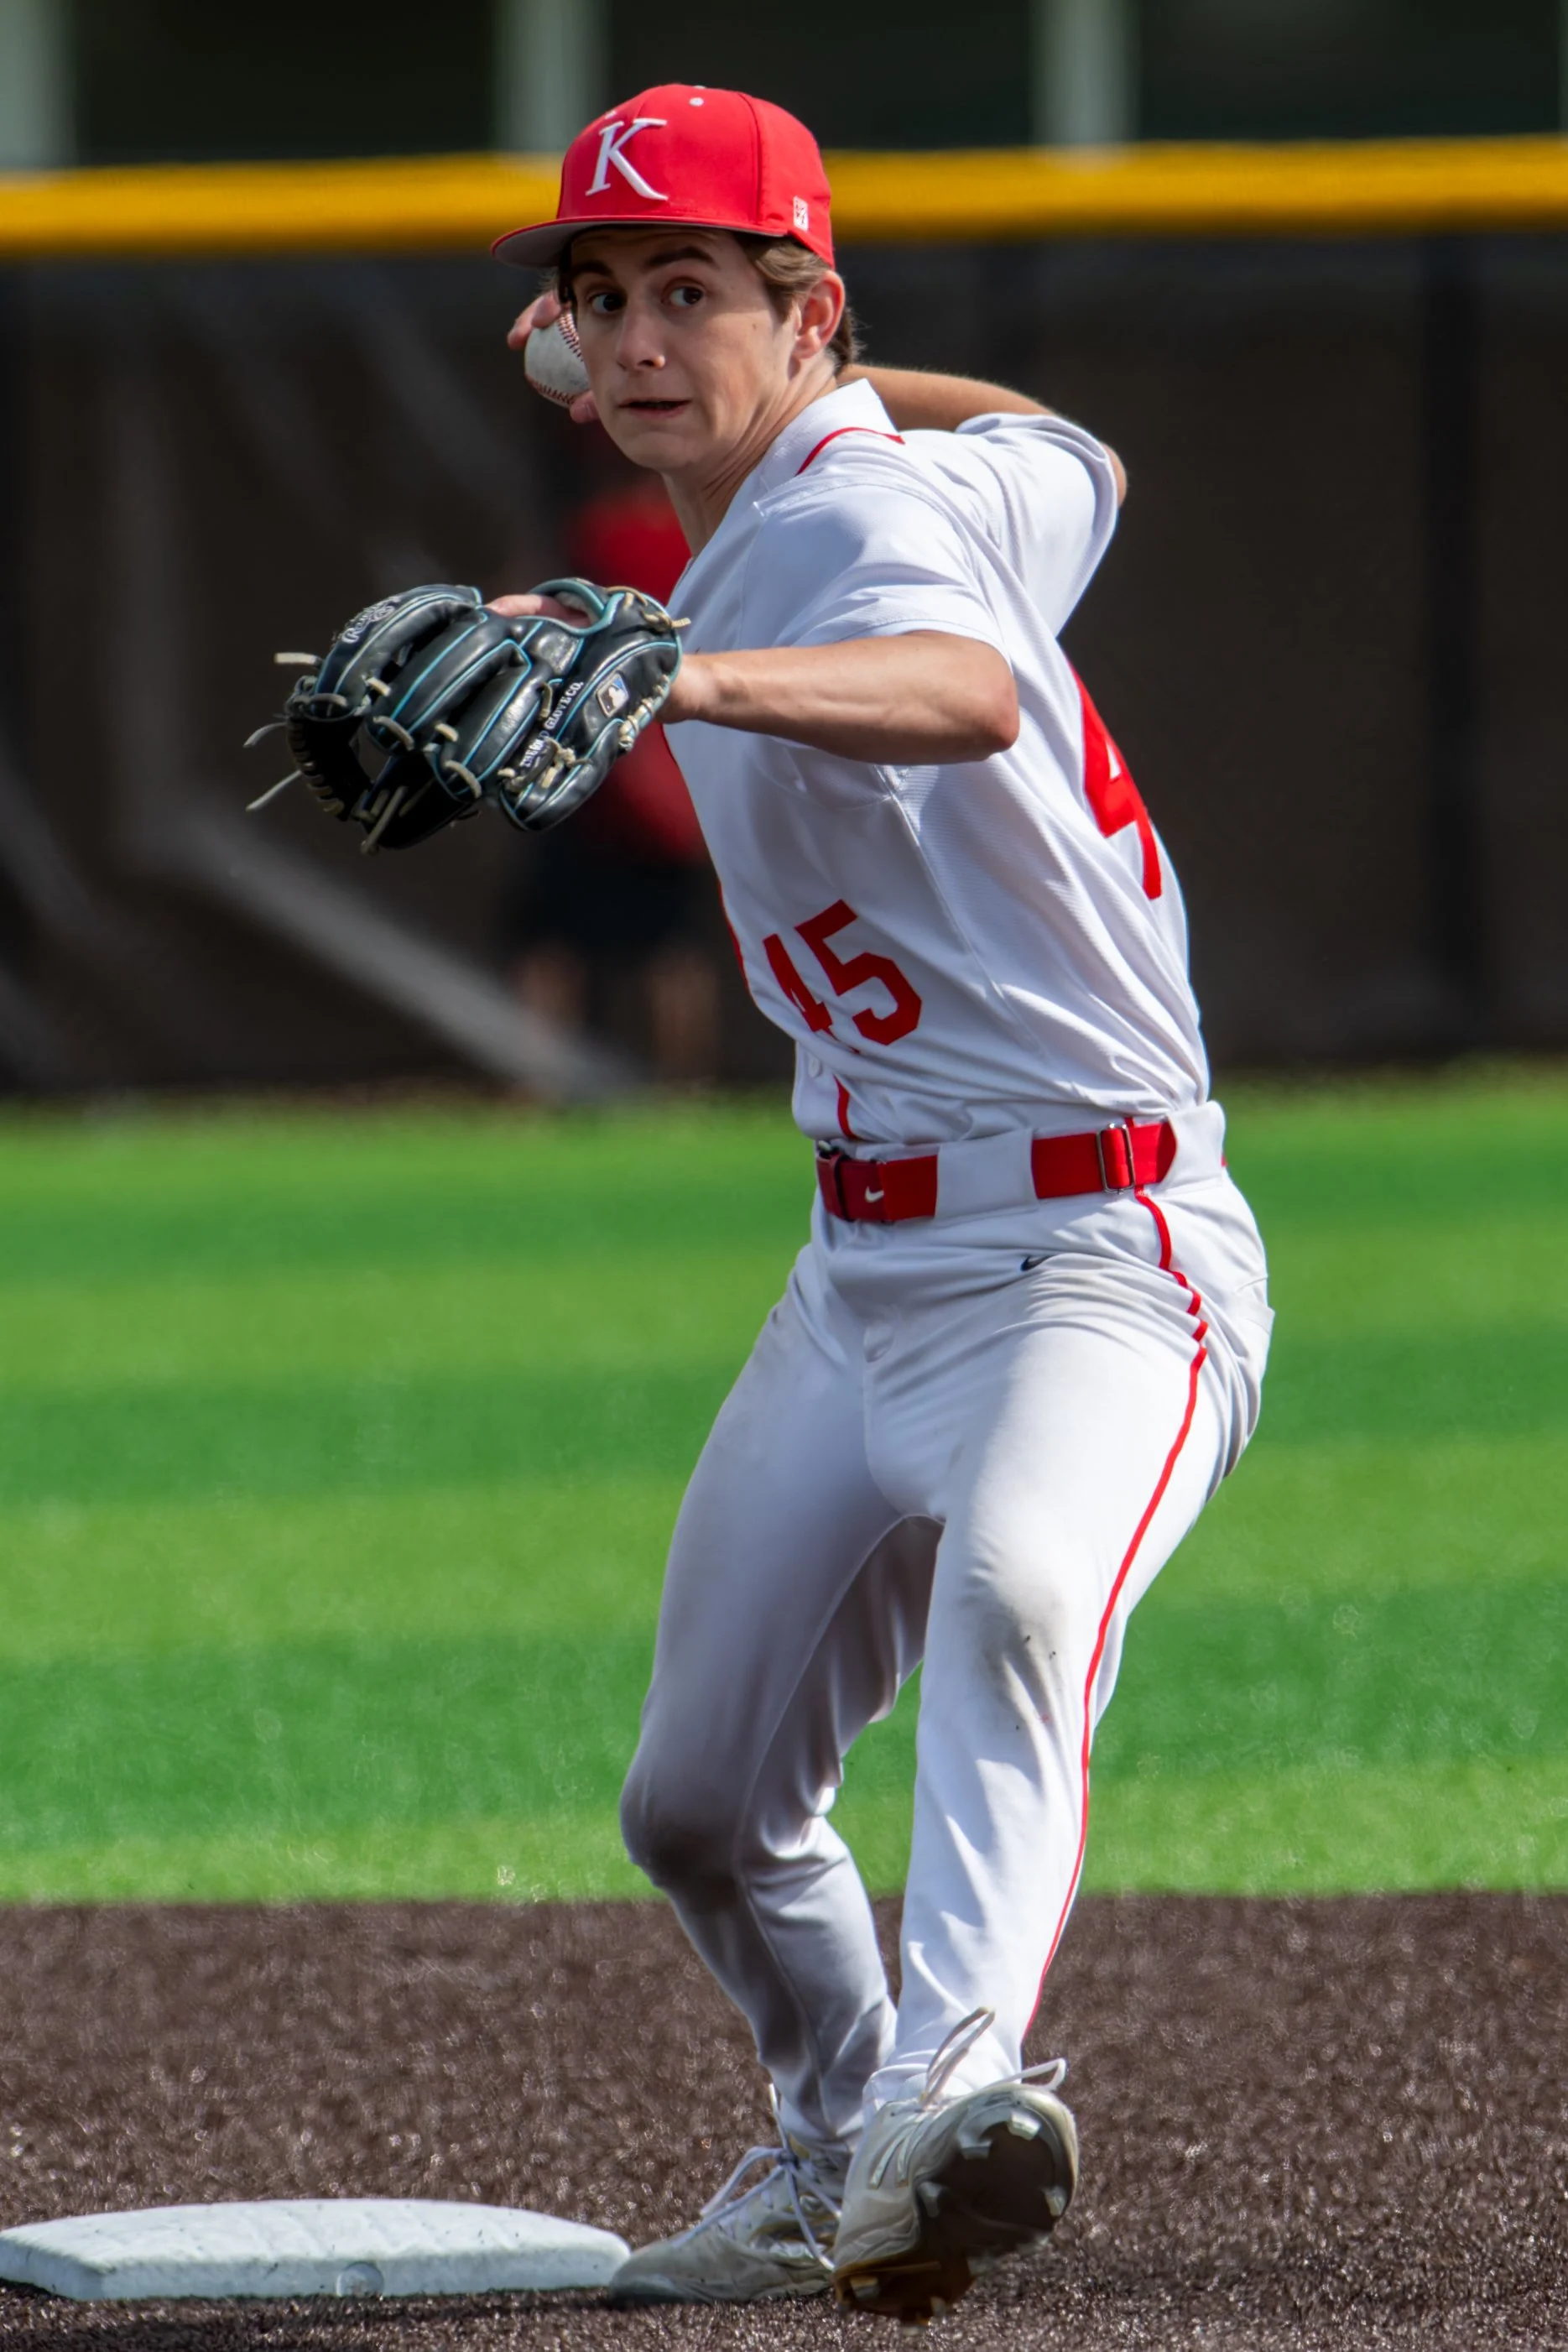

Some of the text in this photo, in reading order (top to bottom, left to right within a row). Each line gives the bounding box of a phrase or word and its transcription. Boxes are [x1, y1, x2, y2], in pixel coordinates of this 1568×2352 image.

[586, 117, 668, 201] K
[543, 696, 572, 730] GLOVE
[565, 681, 585, 697] CO.
[762, 899, 922, 1049] 45
